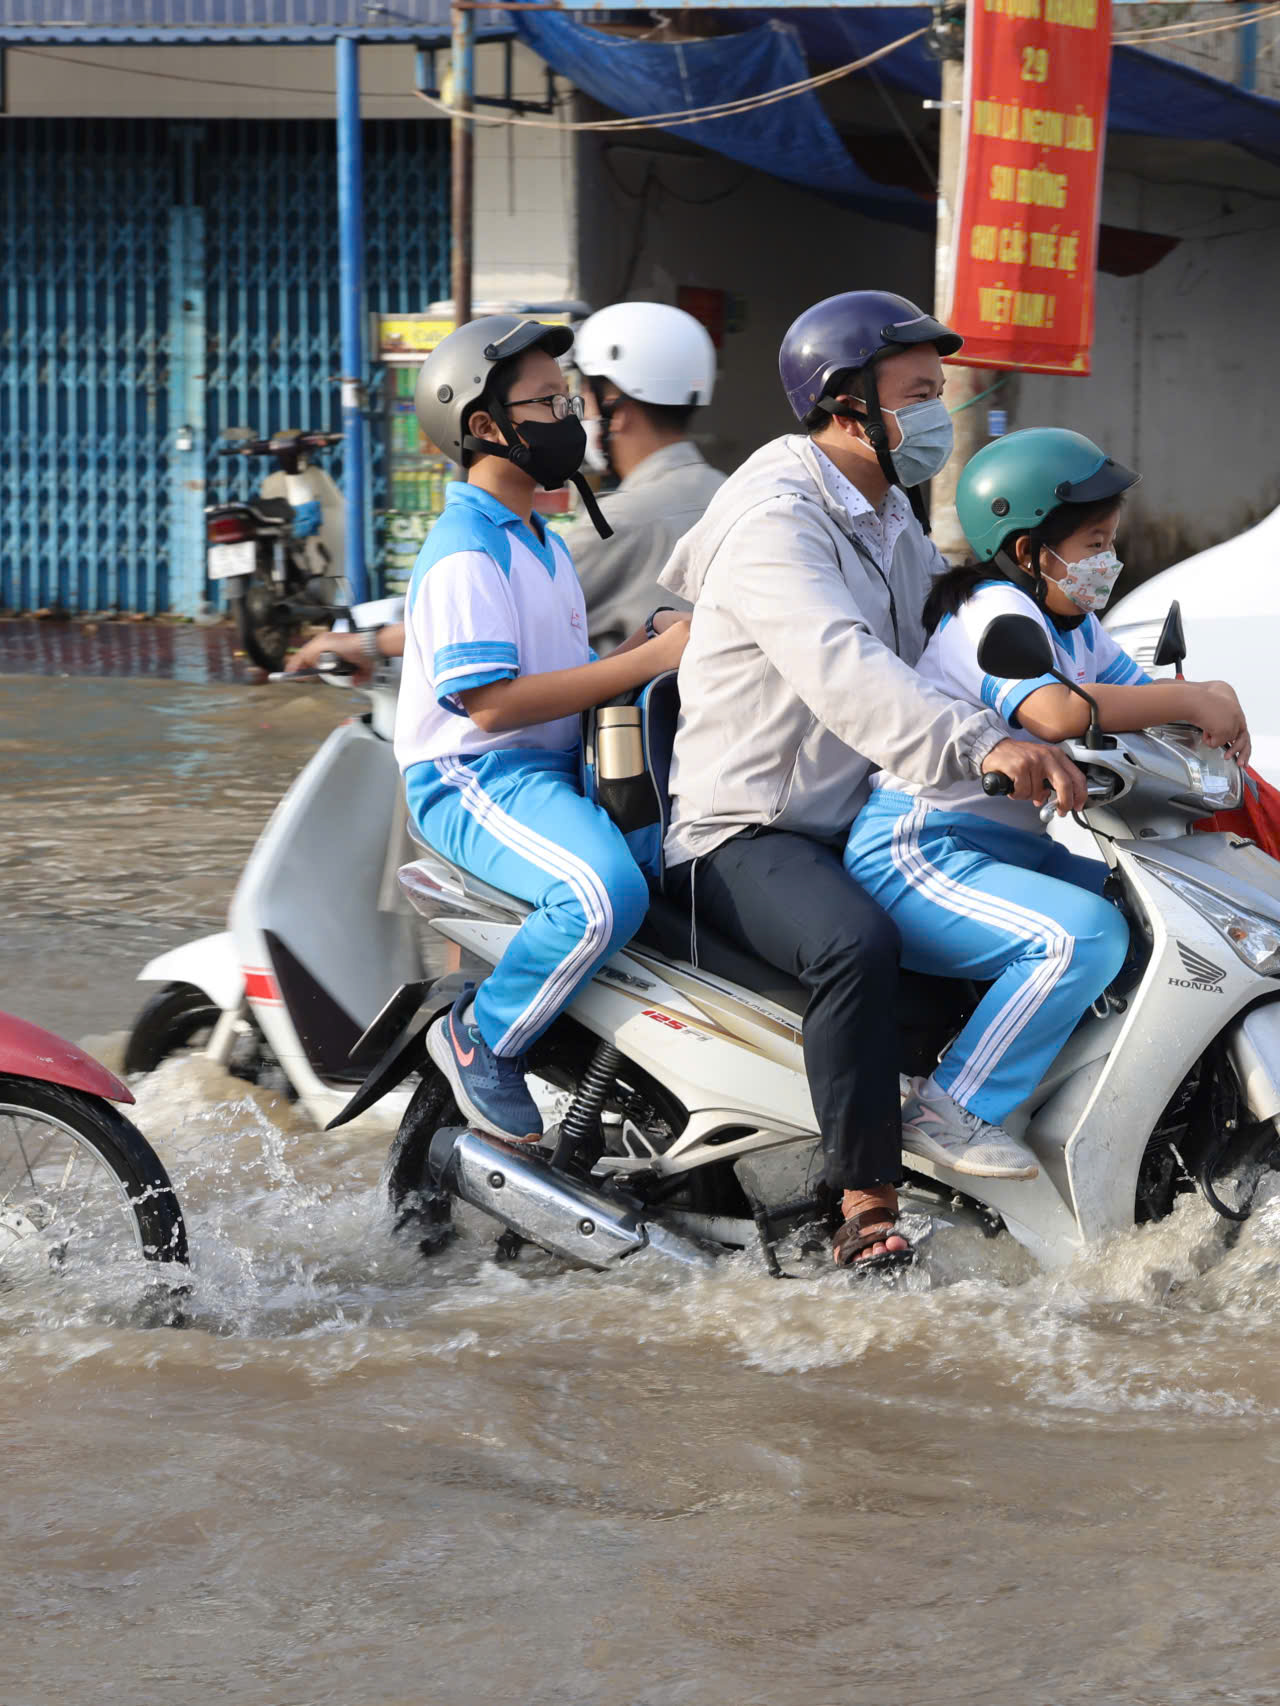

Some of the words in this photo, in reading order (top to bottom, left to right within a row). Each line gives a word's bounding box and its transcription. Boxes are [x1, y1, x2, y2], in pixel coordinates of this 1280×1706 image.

[999, 222, 1026, 264] CÁC
[1030, 223, 1060, 270] THẾ
[1058, 230, 1080, 279] HỆ
[979, 281, 1014, 331] VIỆT
[1168, 977, 1224, 994] HONDA
[641, 1010, 688, 1030] 125
